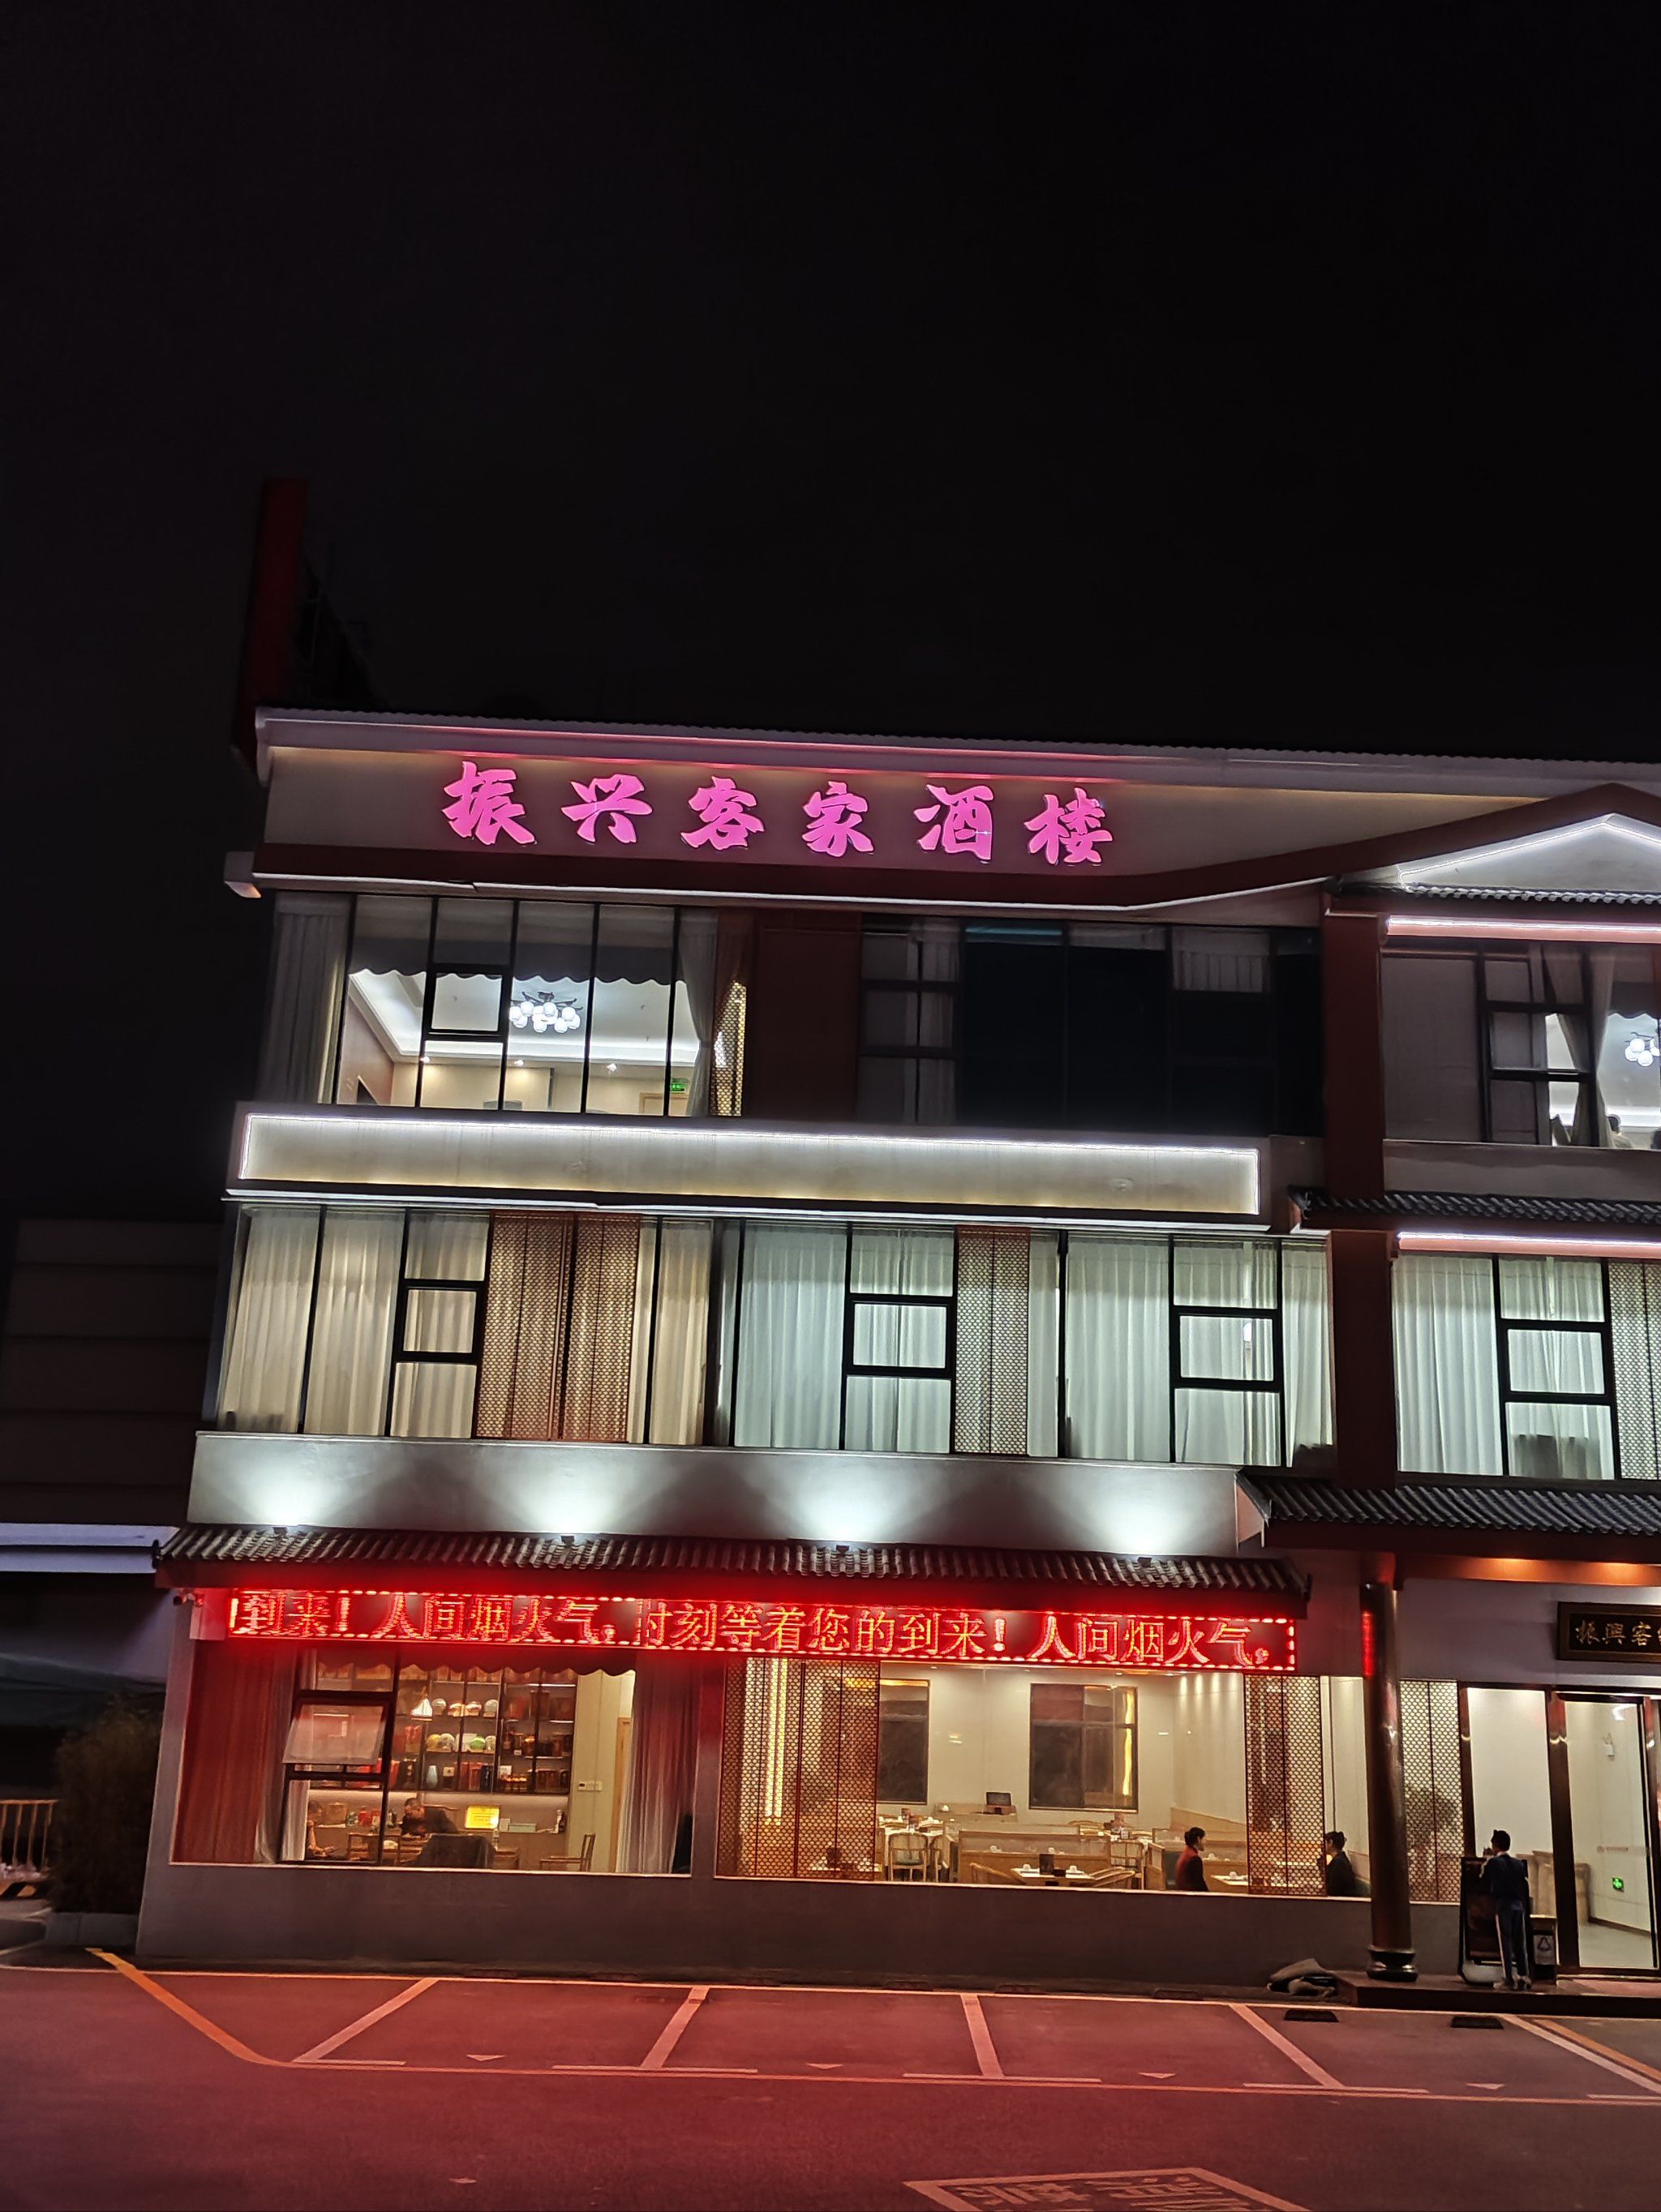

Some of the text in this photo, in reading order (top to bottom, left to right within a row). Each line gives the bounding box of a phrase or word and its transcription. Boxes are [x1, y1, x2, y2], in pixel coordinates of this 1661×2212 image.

[441, 760, 1114, 865] 振兴客家酒楼
[1574, 1620, 1661, 1647] 振興客
